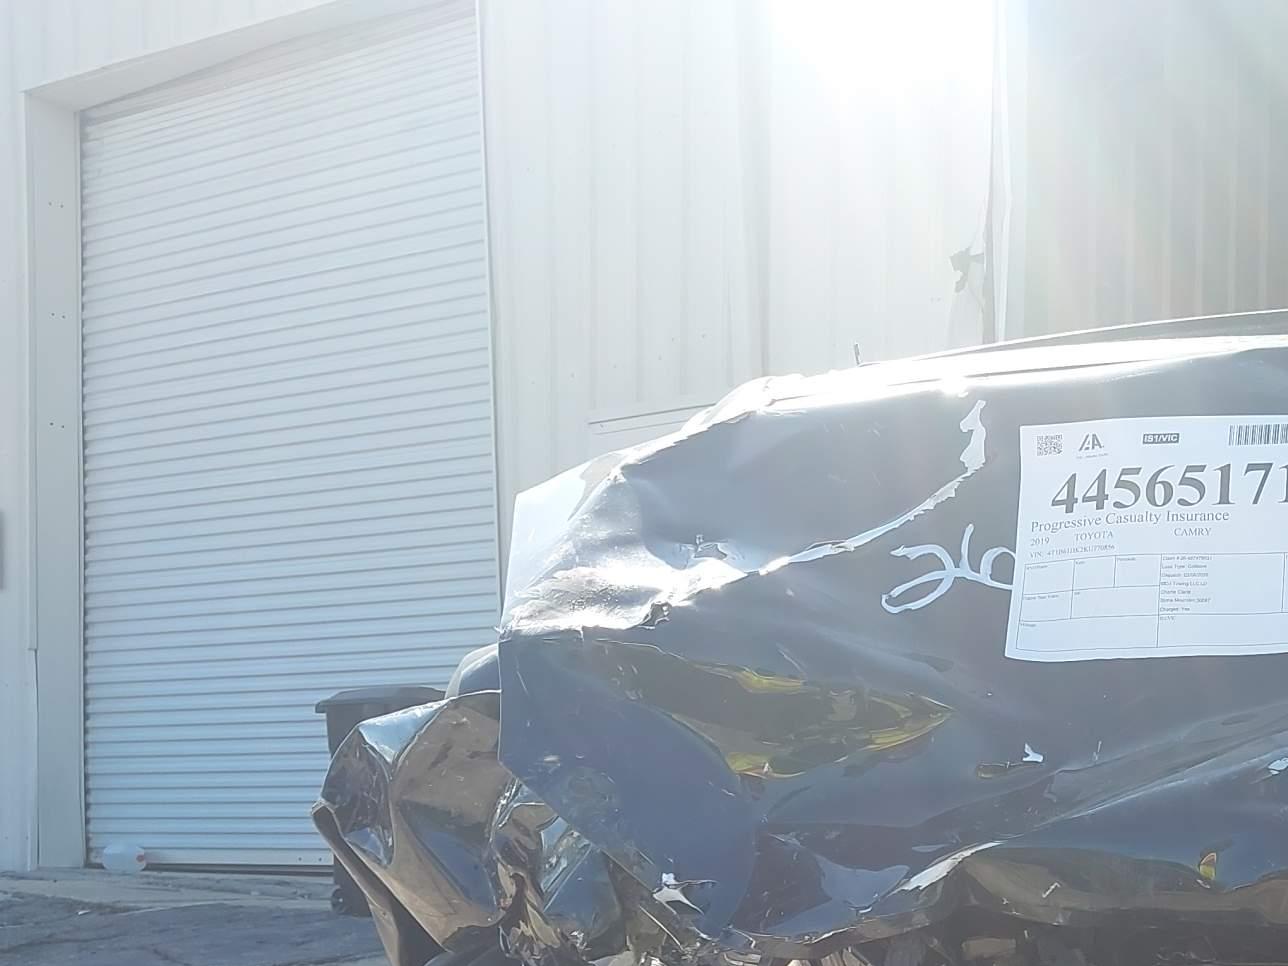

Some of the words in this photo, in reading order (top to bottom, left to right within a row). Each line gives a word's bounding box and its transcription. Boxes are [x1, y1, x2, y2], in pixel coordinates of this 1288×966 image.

[1031, 516, 1102, 533] Progressive
[1105, 511, 1161, 525] Casualty
[1166, 510, 1230, 522] Insurance
[1031, 537, 1050, 546] 2019
[1075, 530, 1114, 541] TOYOTA
[1174, 527, 1212, 537] CAMRY
